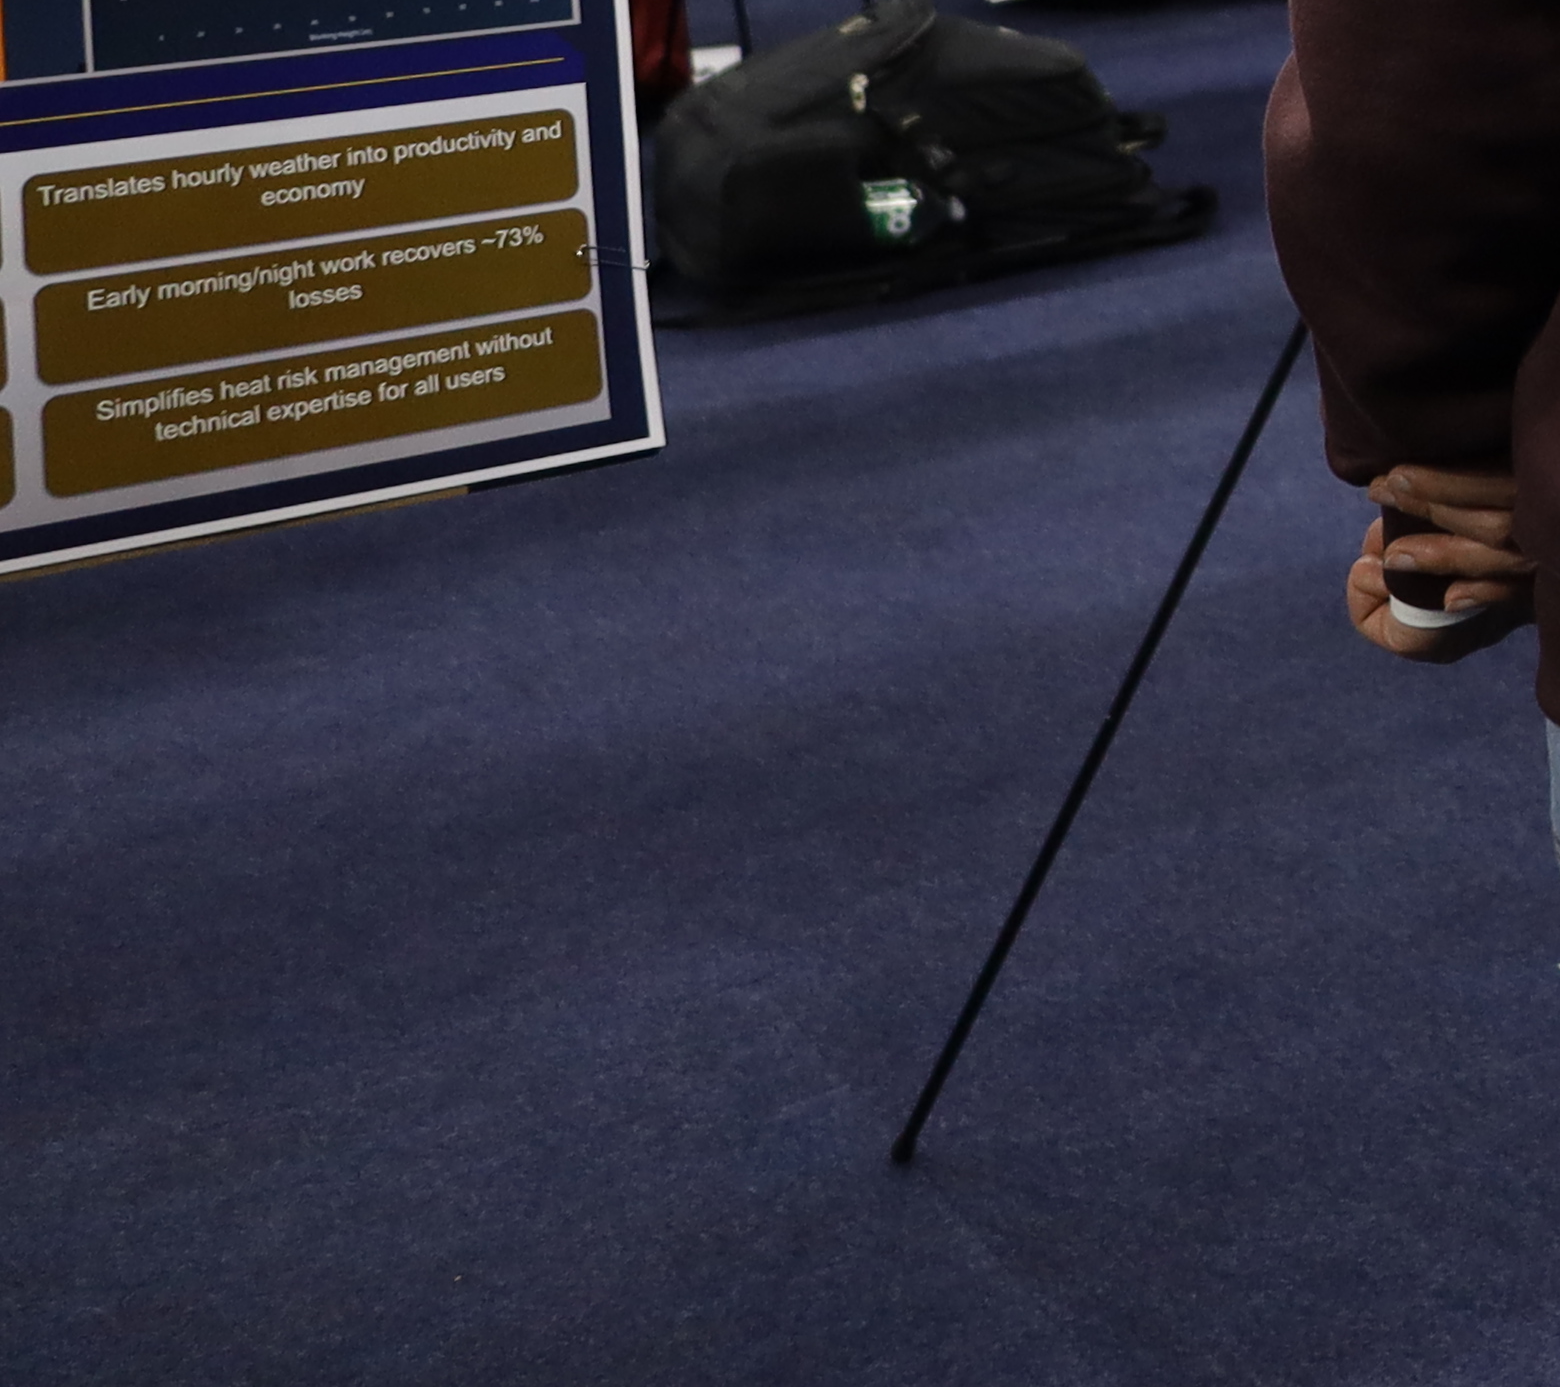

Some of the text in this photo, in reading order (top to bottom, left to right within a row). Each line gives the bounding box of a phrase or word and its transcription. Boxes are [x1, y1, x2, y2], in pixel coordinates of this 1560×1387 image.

[37, 120, 561, 206] Translates hourly weather into productivity and
[261, 179, 365, 206] economy
[87, 225, 543, 310] Early morning/night work recovers ~73%
[289, 285, 362, 308] losses
[97, 327, 552, 421] Simplifies heat risk management without
